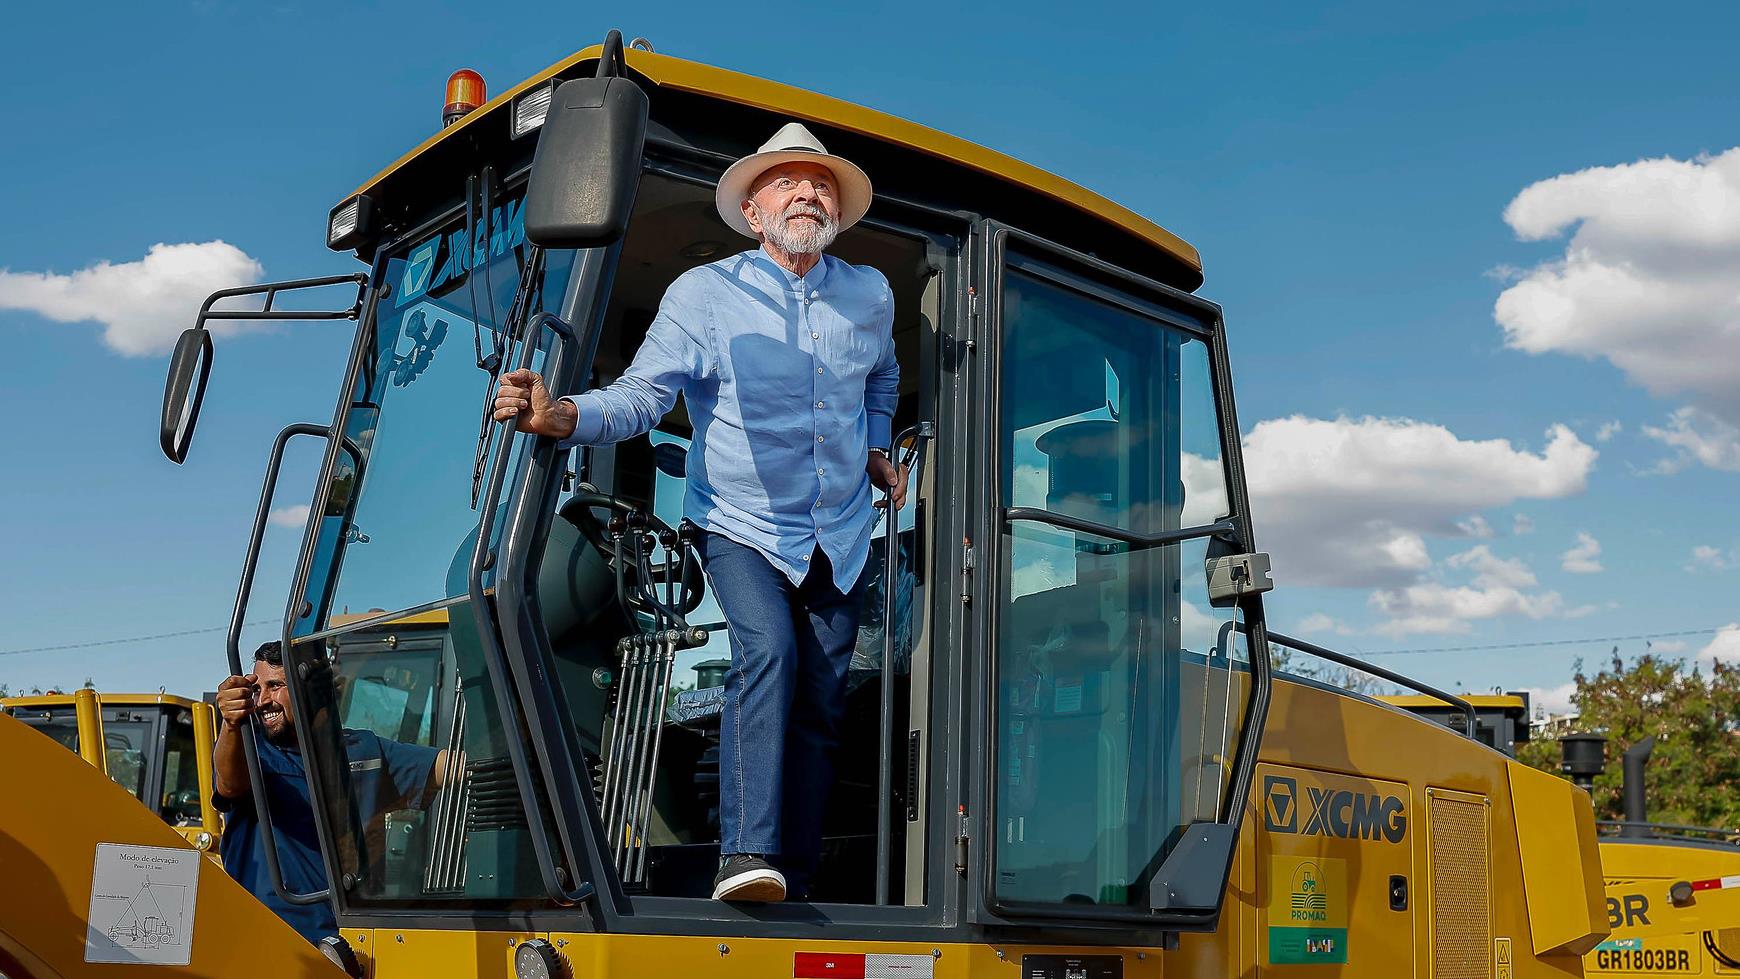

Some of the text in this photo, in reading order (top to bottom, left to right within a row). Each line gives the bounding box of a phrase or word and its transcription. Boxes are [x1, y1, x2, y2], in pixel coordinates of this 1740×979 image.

[427, 192, 527, 292] XCM
[1301, 786, 1407, 843] XCMG
[120, 853, 140, 861] Modo
[151, 856, 179, 865] elevação
[1597, 949, 1690, 970] GR1803BR
